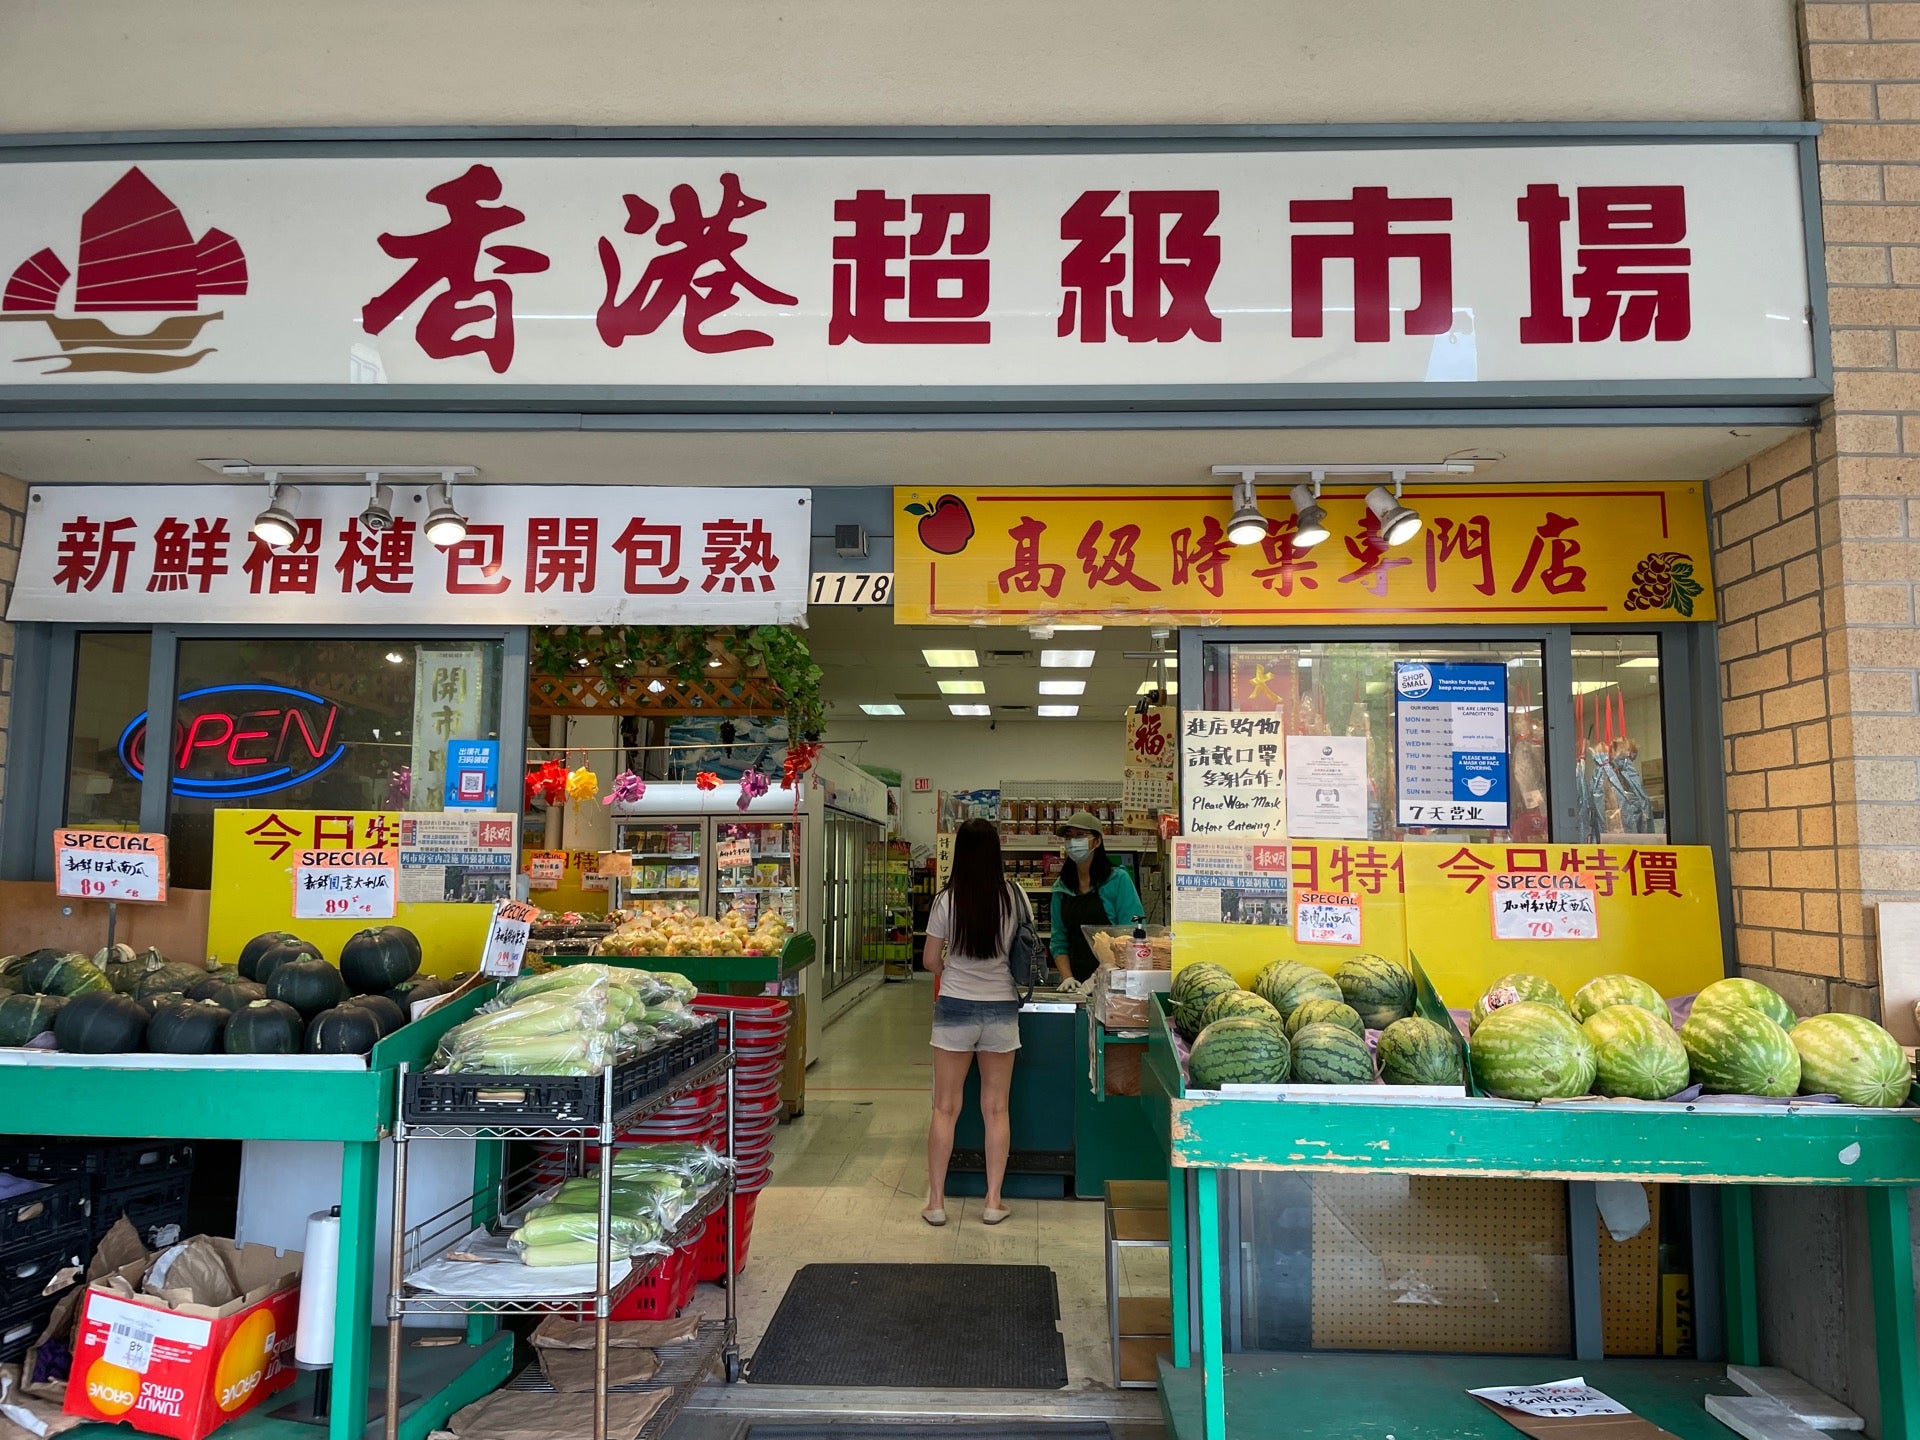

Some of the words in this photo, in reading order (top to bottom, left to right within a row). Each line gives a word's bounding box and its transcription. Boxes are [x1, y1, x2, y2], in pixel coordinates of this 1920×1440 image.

[362, 164, 1691, 373] 香港超級市場
[53, 516, 780, 595] 新鮮榴槤包開包熟
[814, 576, 890, 602] 1178
[1249, 664, 1282, 703] 大
[1402, 673, 1424, 682] SHOP
[1402, 680, 1428, 688] SMALL
[130, 706, 337, 770] OPEN
[1134, 713, 1165, 755] 福
[1188, 744, 1277, 766] 請戴口罩
[915, 778, 929, 789] EXIT
[1192, 796, 1222, 810] Please
[64, 834, 154, 851] SPECIAL
[302, 852, 388, 866] SPECIAL
[1437, 847, 1682, 898] 今日特價
[1497, 875, 1585, 889] SPECIAL
[1302, 894, 1357, 905] SPECIAL
[129, 1340, 142, 1351] 48
[89, 1382, 134, 1405] GROVE
[140, 1382, 184, 1401] CITRUS
[220, 1370, 261, 1407] GROVE
[136, 1396, 180, 1417] TUMUT
